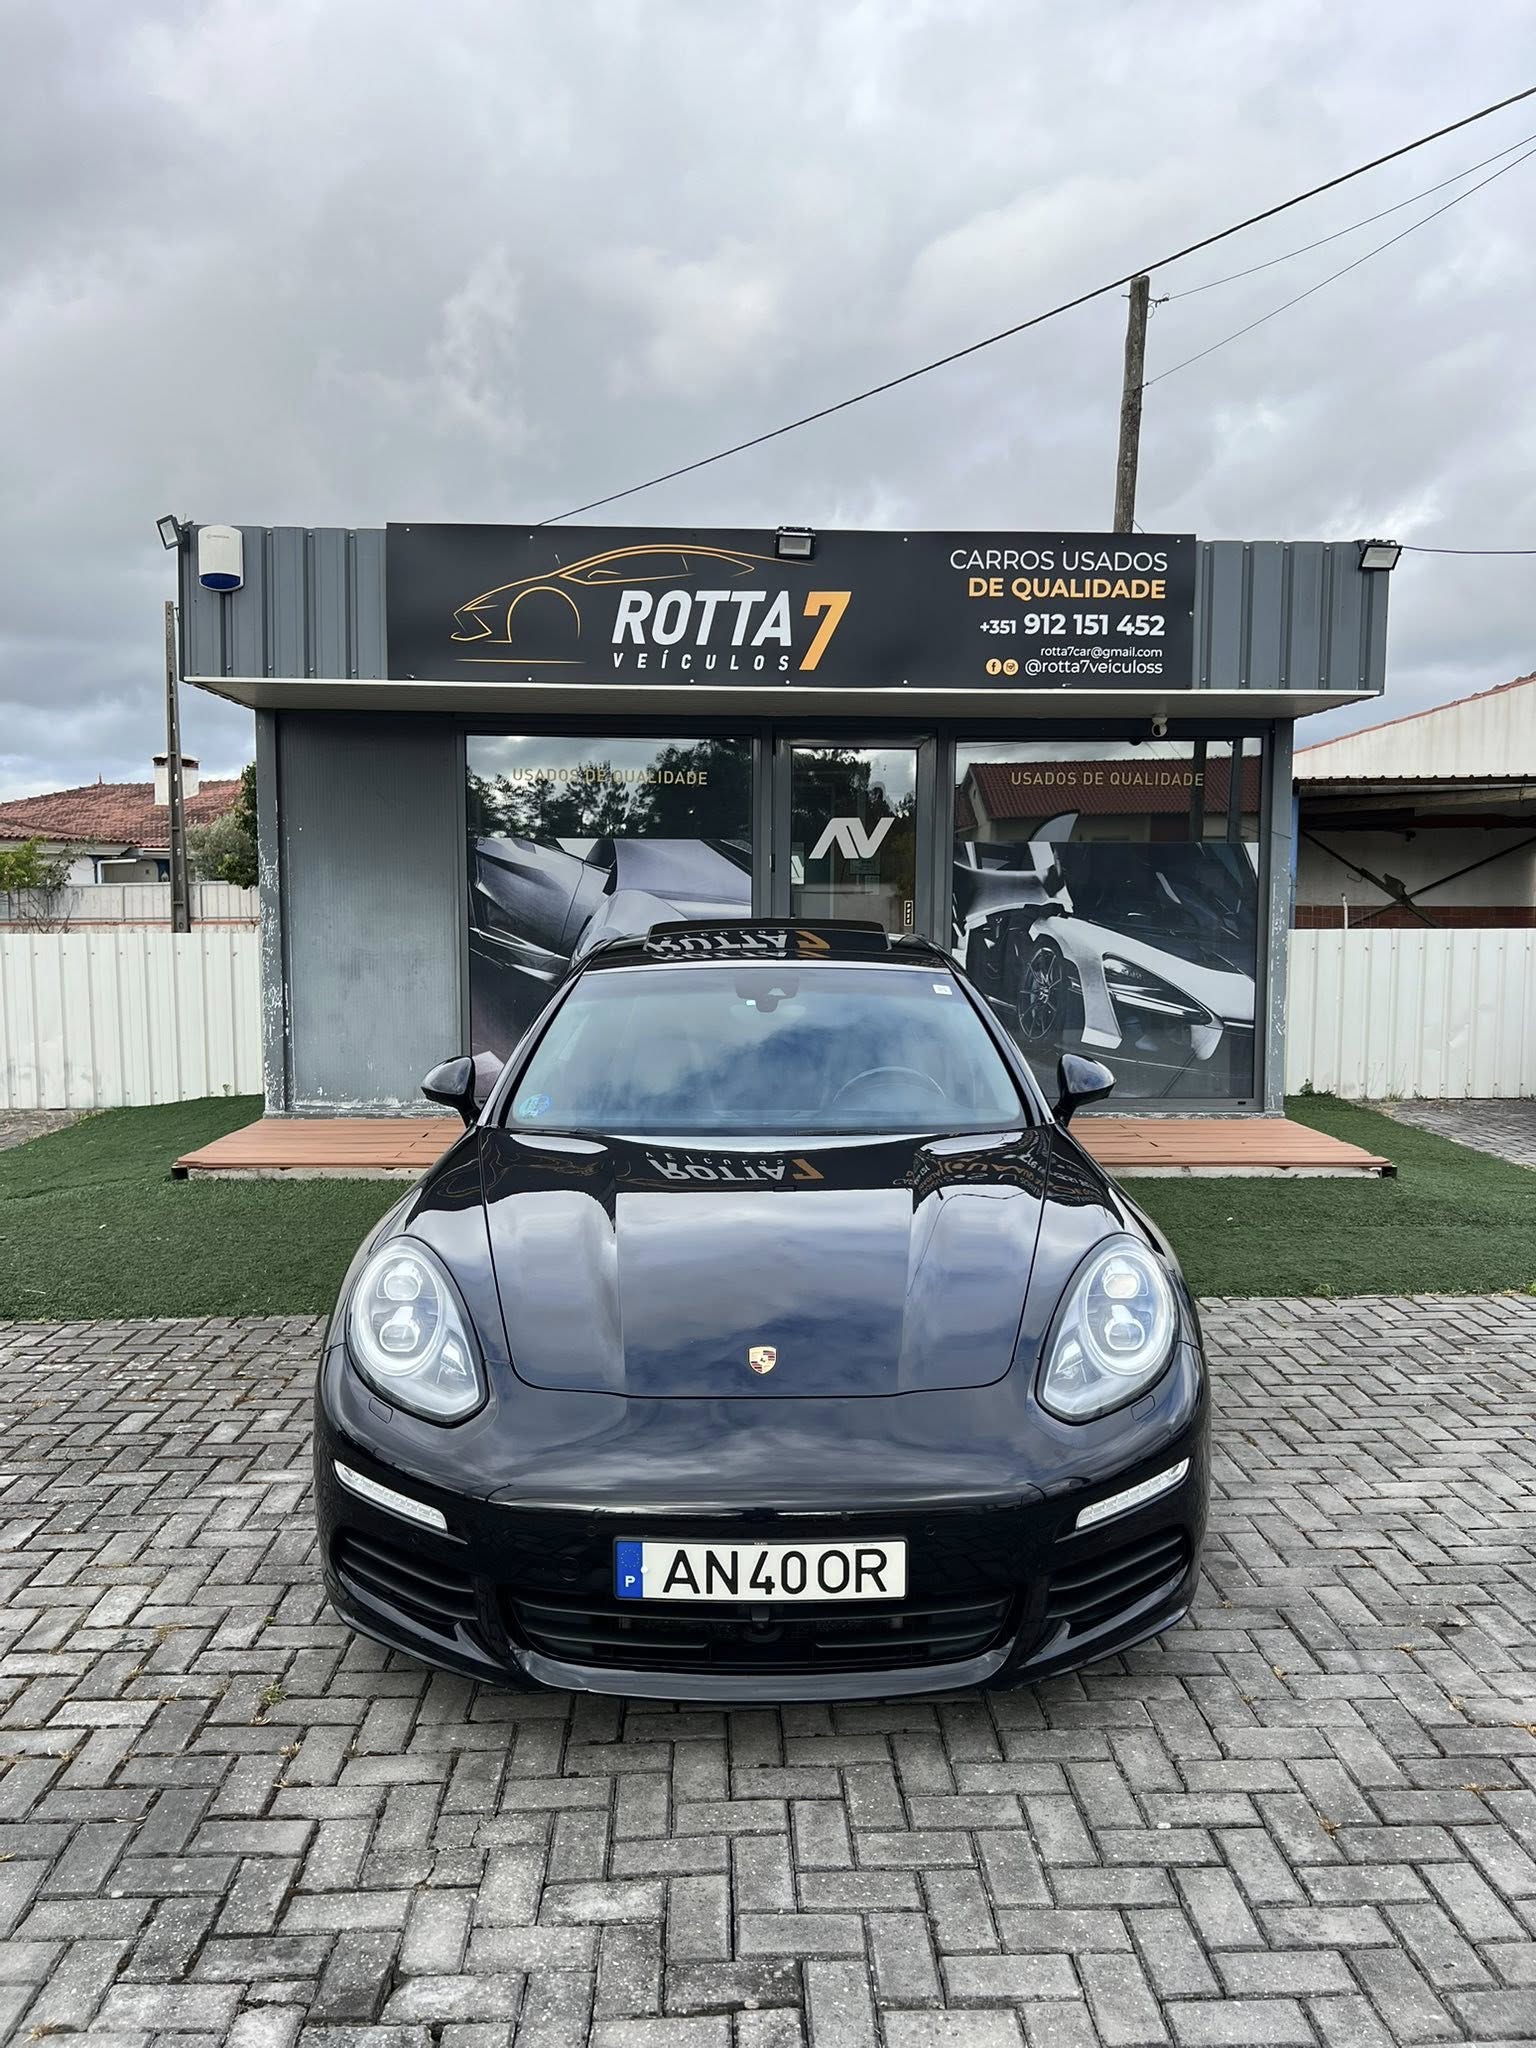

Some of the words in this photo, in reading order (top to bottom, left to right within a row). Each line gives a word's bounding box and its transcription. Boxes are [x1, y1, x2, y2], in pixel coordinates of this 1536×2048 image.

[950, 549, 1055, 571] CARROS
[1062, 551, 1168, 572] USADOS
[968, 577, 1004, 597] DE
[1011, 577, 1166, 601] QUALIDADE
[611, 590, 792, 647] ROTTA
[799, 591, 852, 671] 7
[979, 619, 1017, 635] +351
[1023, 613, 1067, 635] 912
[1073, 614, 1108, 635] 151
[1116, 614, 1166, 636] 452
[612, 649, 790, 671] VEÍCULOS
[1040, 646, 1163, 659] rotta7car@gmail.com
[1024, 658, 1163, 675] @rotta7veiculoss
[513, 768, 578, 782] USADOS
[585, 769, 605, 783] DE
[612, 770, 708, 785] QUALIDADE
[1011, 772, 1077, 785] USADOS
[1083, 772, 1104, 785] DE
[1110, 772, 1204, 787] QUALIDADE
[625, 1576, 636, 1587] P
